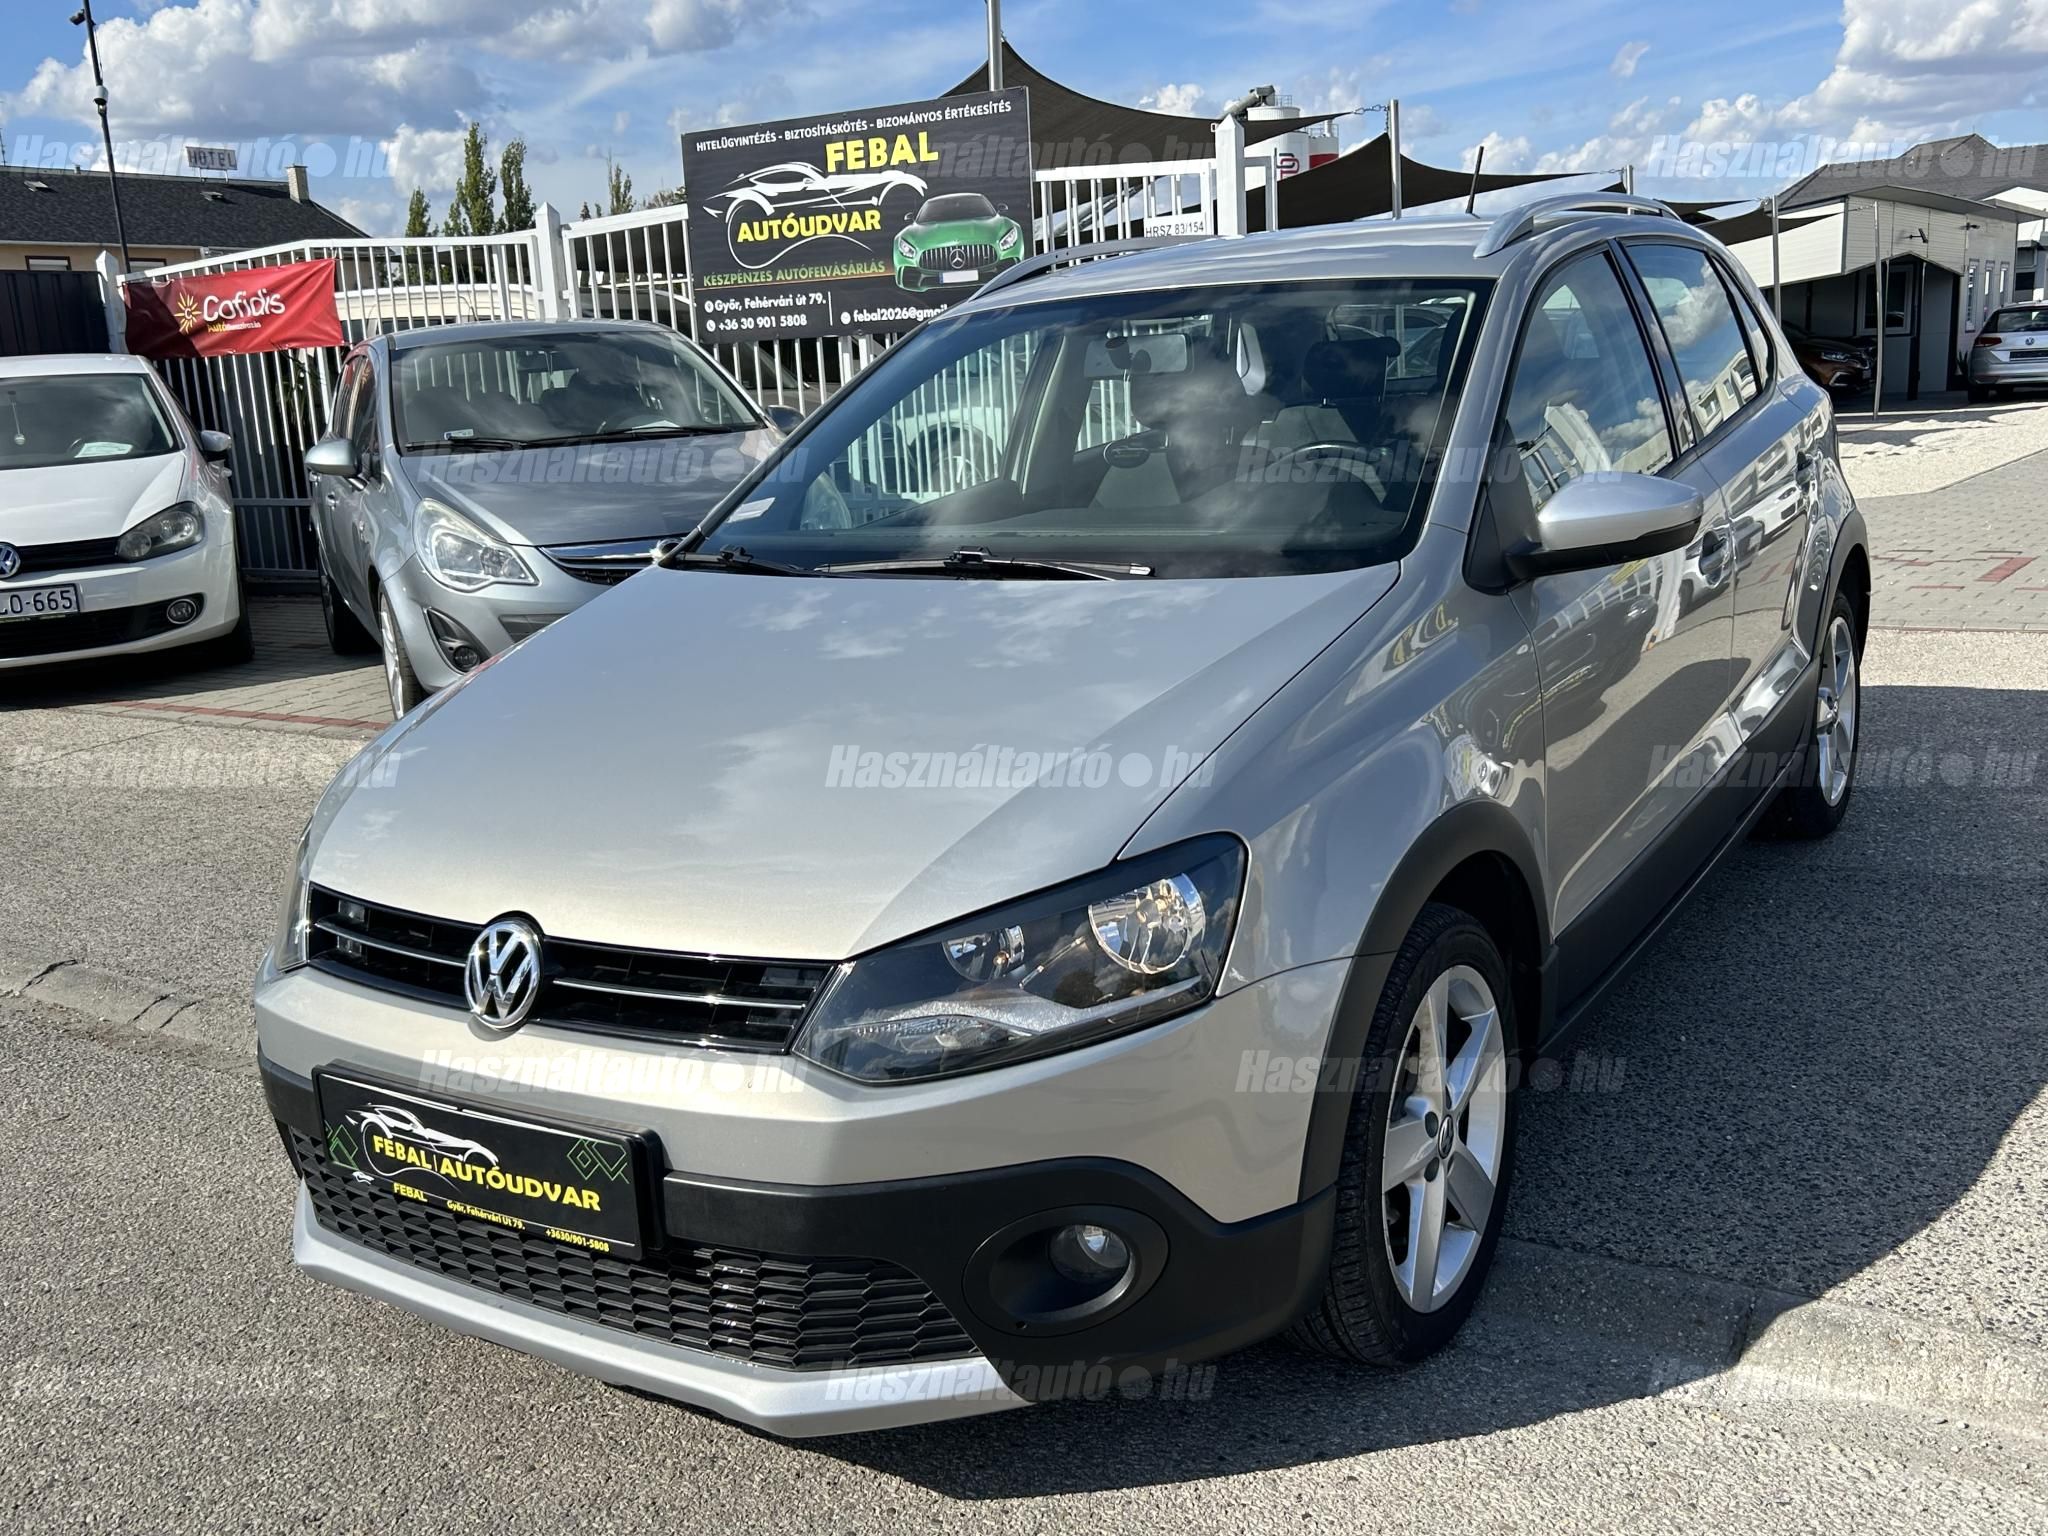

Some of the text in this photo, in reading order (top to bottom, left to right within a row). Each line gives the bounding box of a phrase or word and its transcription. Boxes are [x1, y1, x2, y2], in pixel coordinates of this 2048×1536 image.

[696, 131, 777, 151] HITELÜGYINTÉZÉS
[784, 118, 868, 141] BIZTOSÍTÁSKÖTÉS
[876, 109, 943, 129] BIZOMÁNYOS
[944, 99, 1012, 120] ÉRTÉKESÍTÉS
[188, 150, 236, 167] HOTEL
[825, 131, 939, 173] FEBAL
[737, 209, 882, 242] AUTÓUDVAR
[1145, 221, 1204, 238] HRSZ 83/154
[703, 259, 886, 287] KÉSZPÉNZES AUTÓFELVÁSÁRLÁS
[203, 288, 286, 322] Cofidis
[744, 294, 794, 309] Fehérvári
[808, 292, 826, 304] 79.
[718, 314, 807, 331] +36 30 901 5808
[0, 590, 73, 616] O-665
[373, 1135, 602, 1212] FEBAL AUTÓUDVAR
[393, 1183, 428, 1203] FEBAL
[545, 1229, 610, 1252] +3630/901-5808
